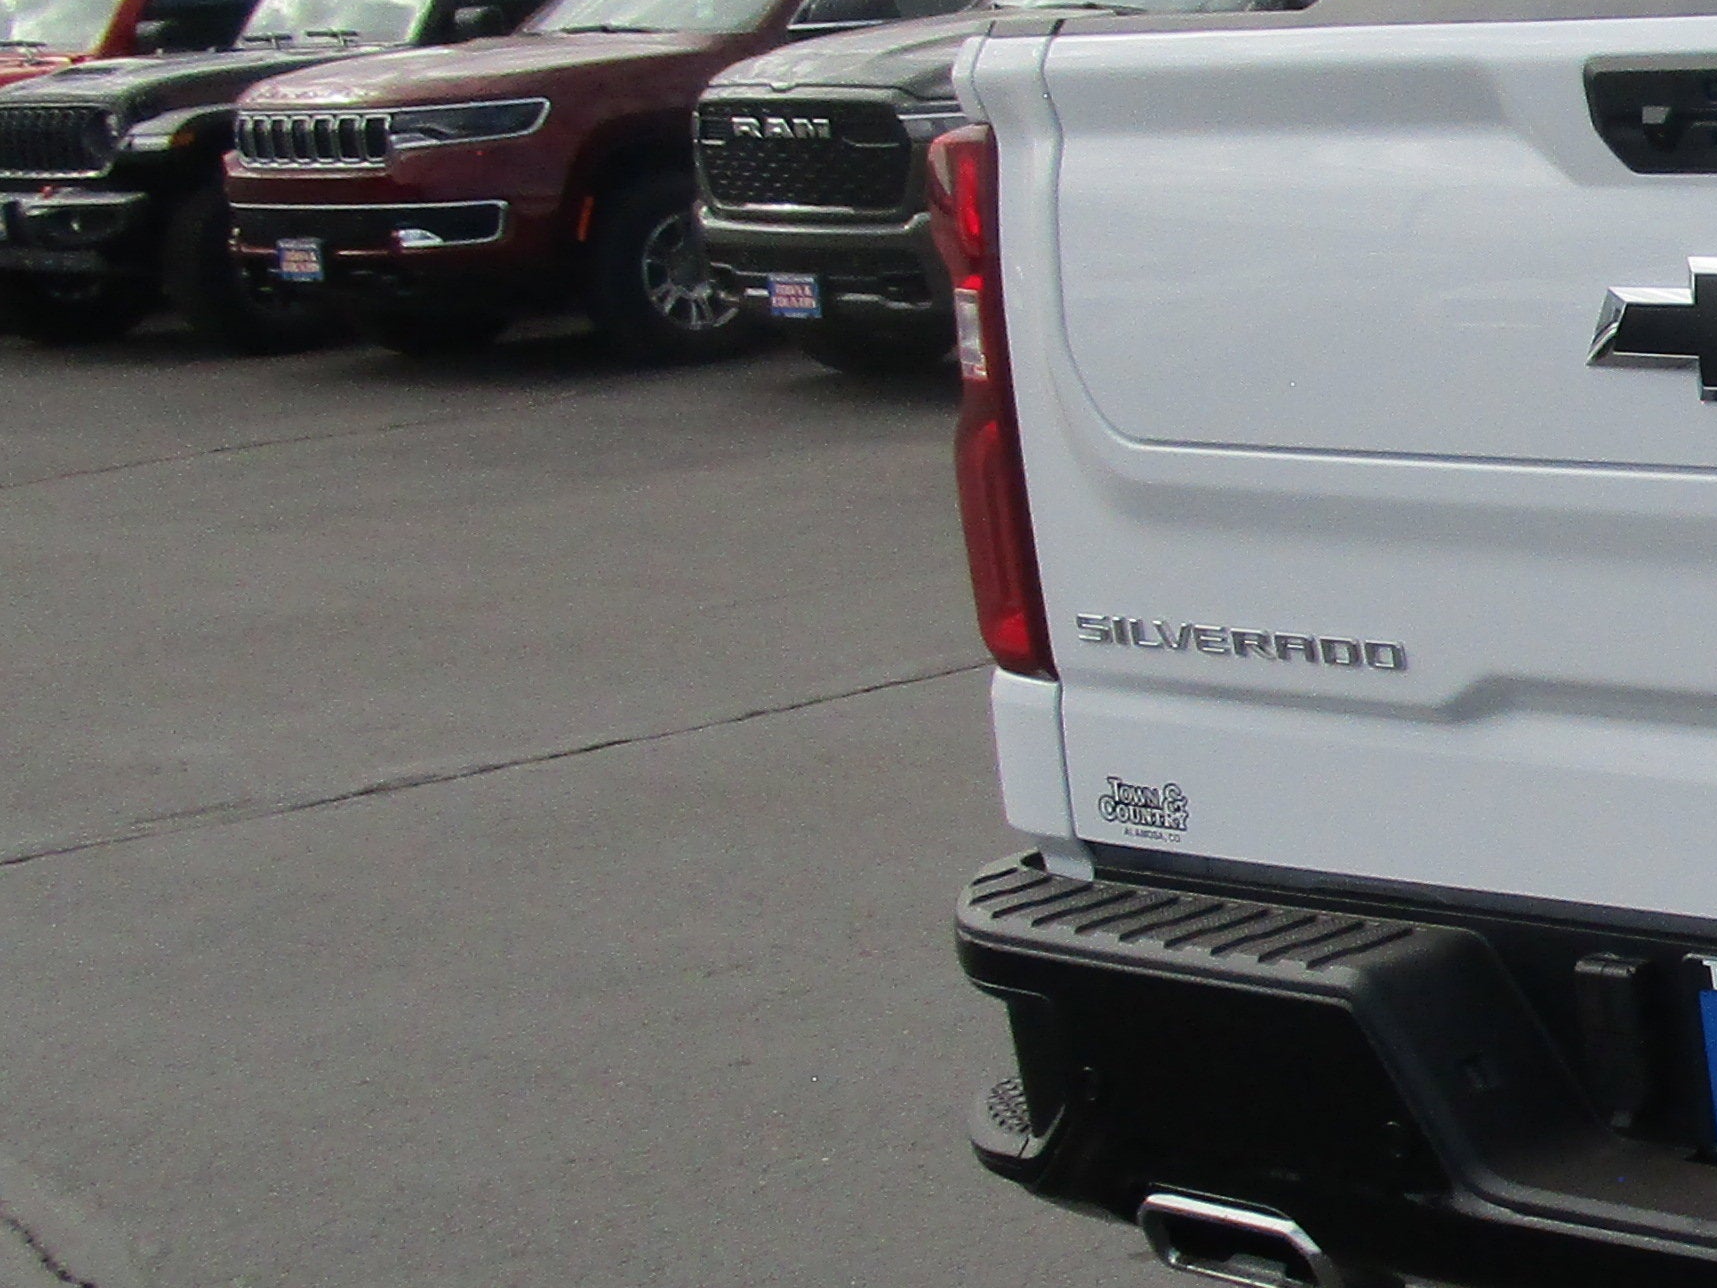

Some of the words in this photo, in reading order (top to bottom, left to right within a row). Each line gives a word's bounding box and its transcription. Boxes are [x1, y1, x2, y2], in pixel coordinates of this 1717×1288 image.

[731, 116, 831, 139] RAM
[1075, 613, 1407, 672] SILVERADO
[1098, 794, 1189, 831] COUNTRY
